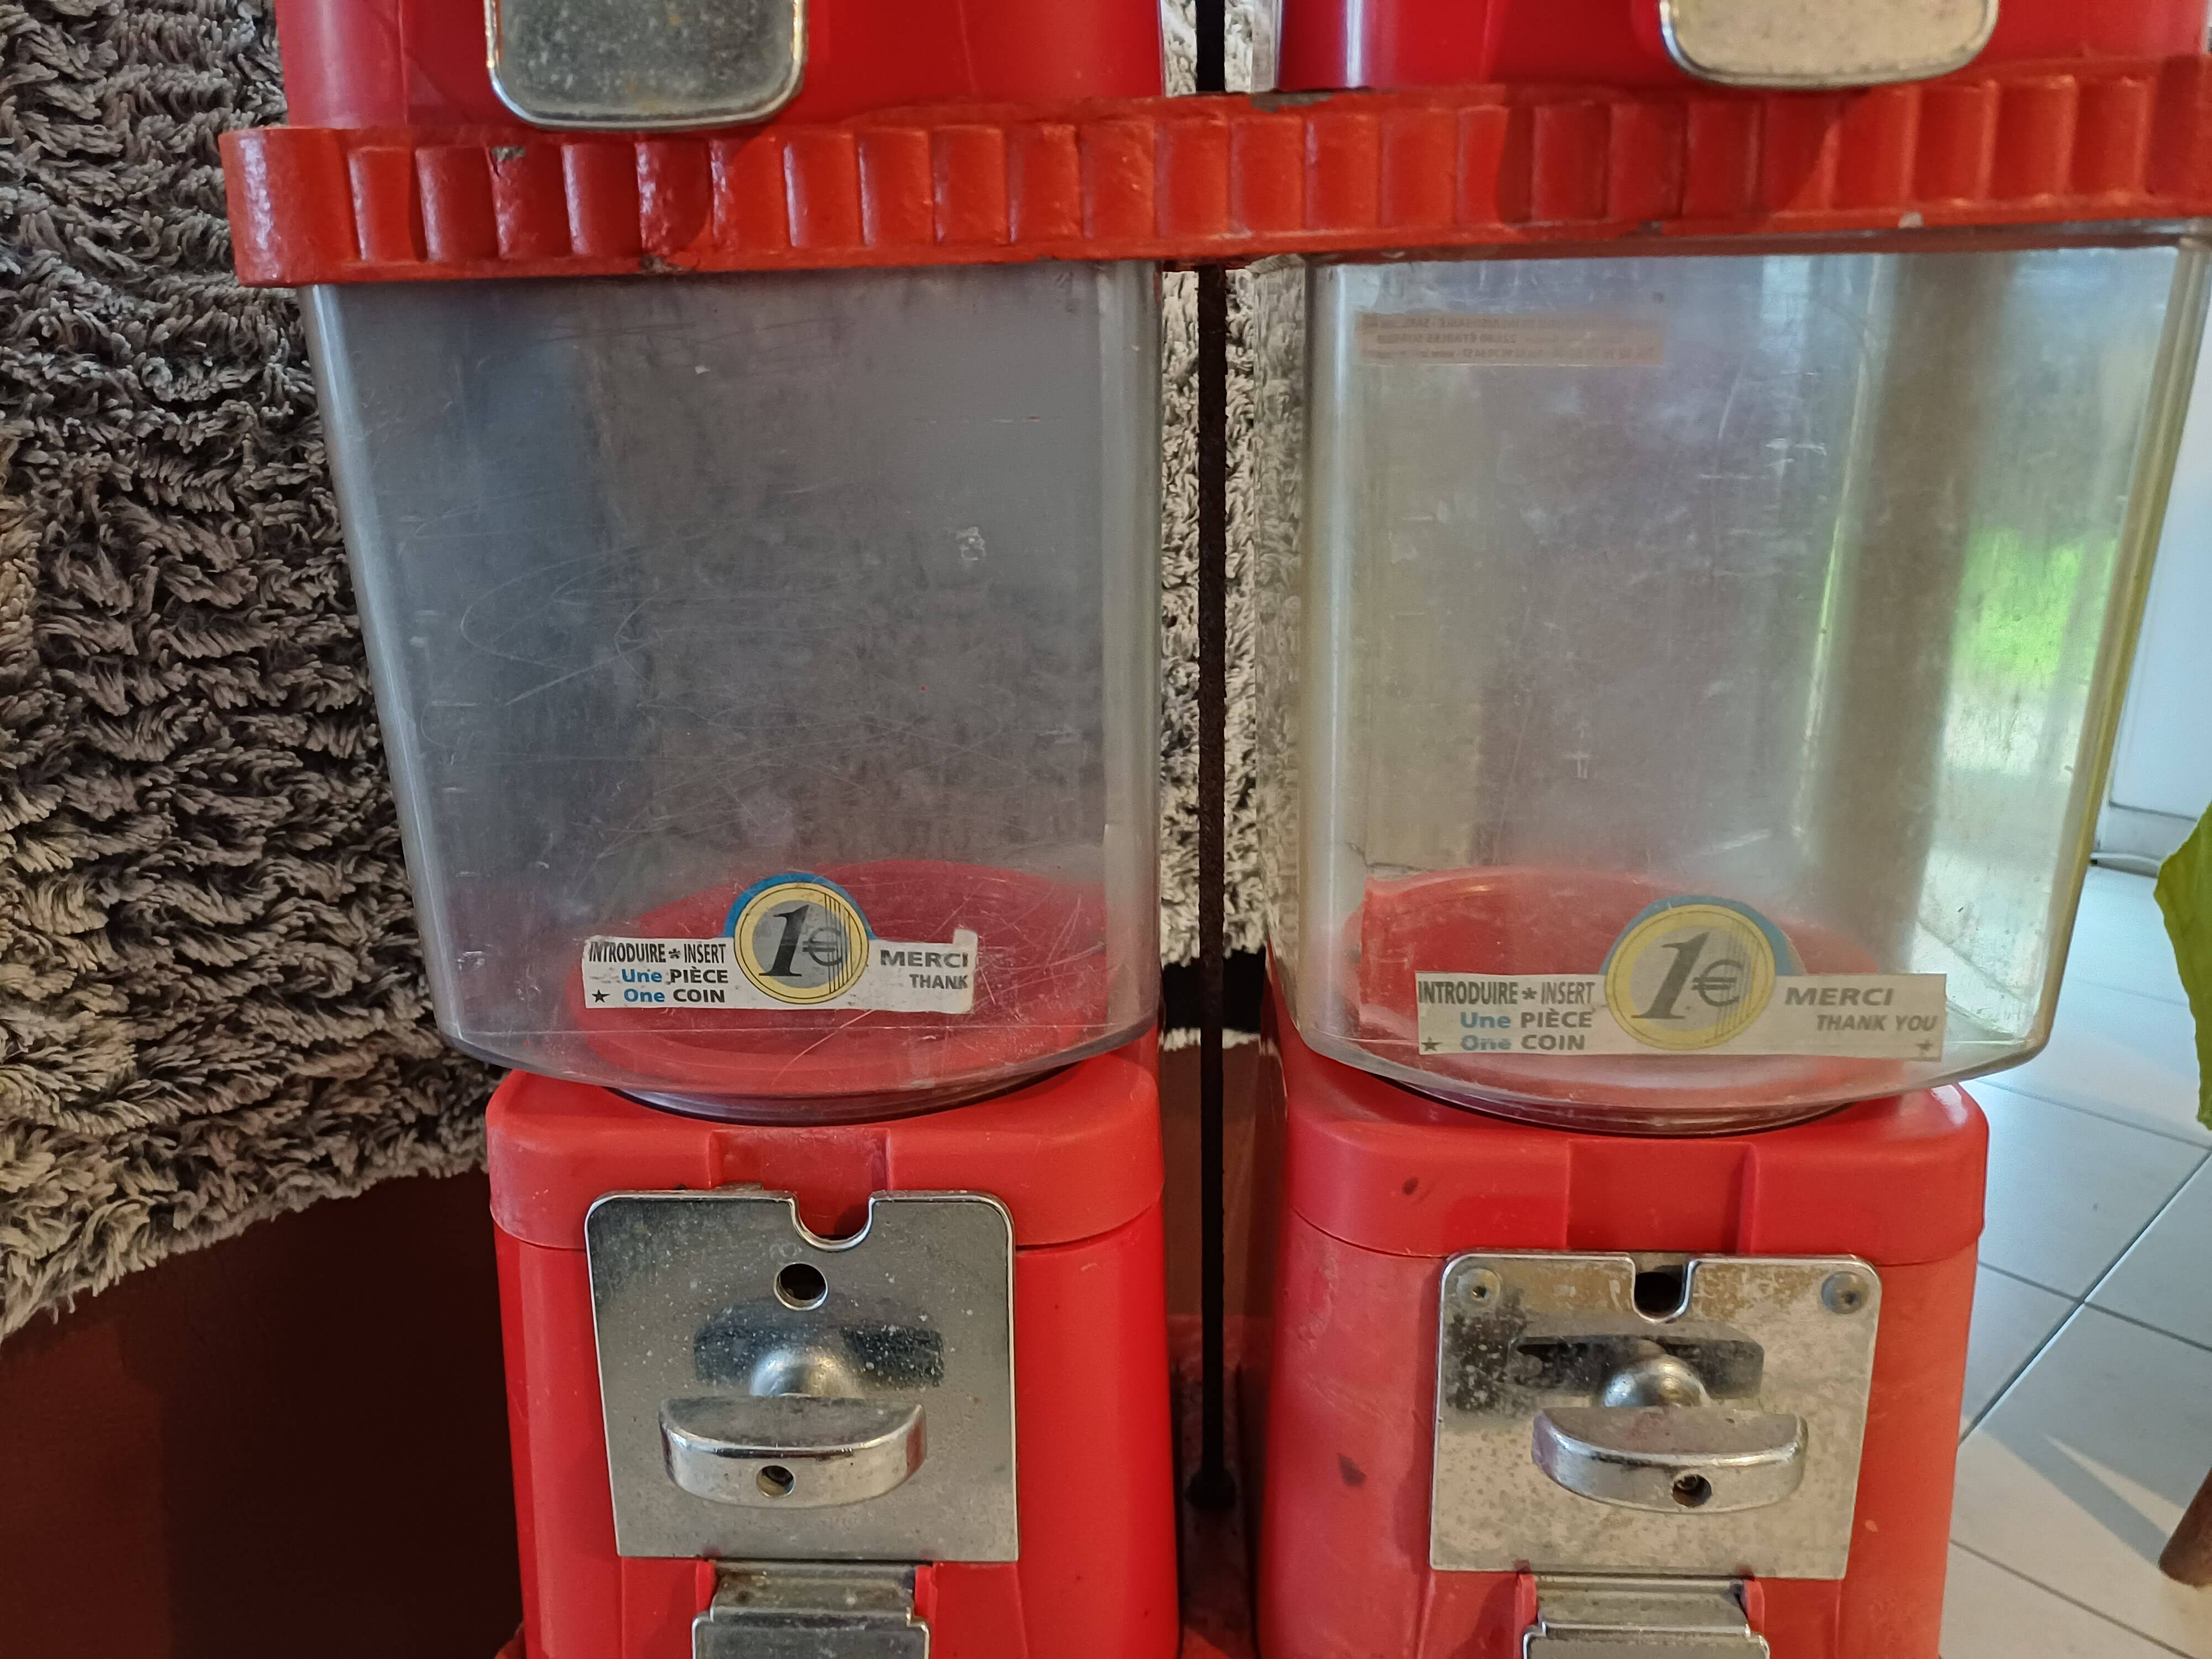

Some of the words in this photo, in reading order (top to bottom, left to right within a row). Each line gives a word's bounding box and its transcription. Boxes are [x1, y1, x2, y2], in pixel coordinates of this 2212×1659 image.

[588, 941, 667, 963] INTRODUIRE
[684, 943, 726, 964] INSERT
[880, 950, 968, 968] MERCI
[621, 968, 662, 983] Une
[670, 966, 729, 984] PIÈCE
[909, 974, 968, 990] THANK
[623, 988, 666, 1003] One
[672, 989, 726, 1003] COIN
[1417, 980, 1519, 1005] INTRODUIRE
[1541, 981, 1596, 1005] INSERT
[1785, 987, 1894, 1006] MERCI
[1460, 1011, 1512, 1029] Une
[1520, 1008, 1592, 1028] PIÈCE
[1817, 1014, 1888, 1031] THANK
[1895, 1015, 1938, 1032] YOU
[1460, 1034, 1512, 1051] One
[1521, 1034, 1585, 1051] COIN
